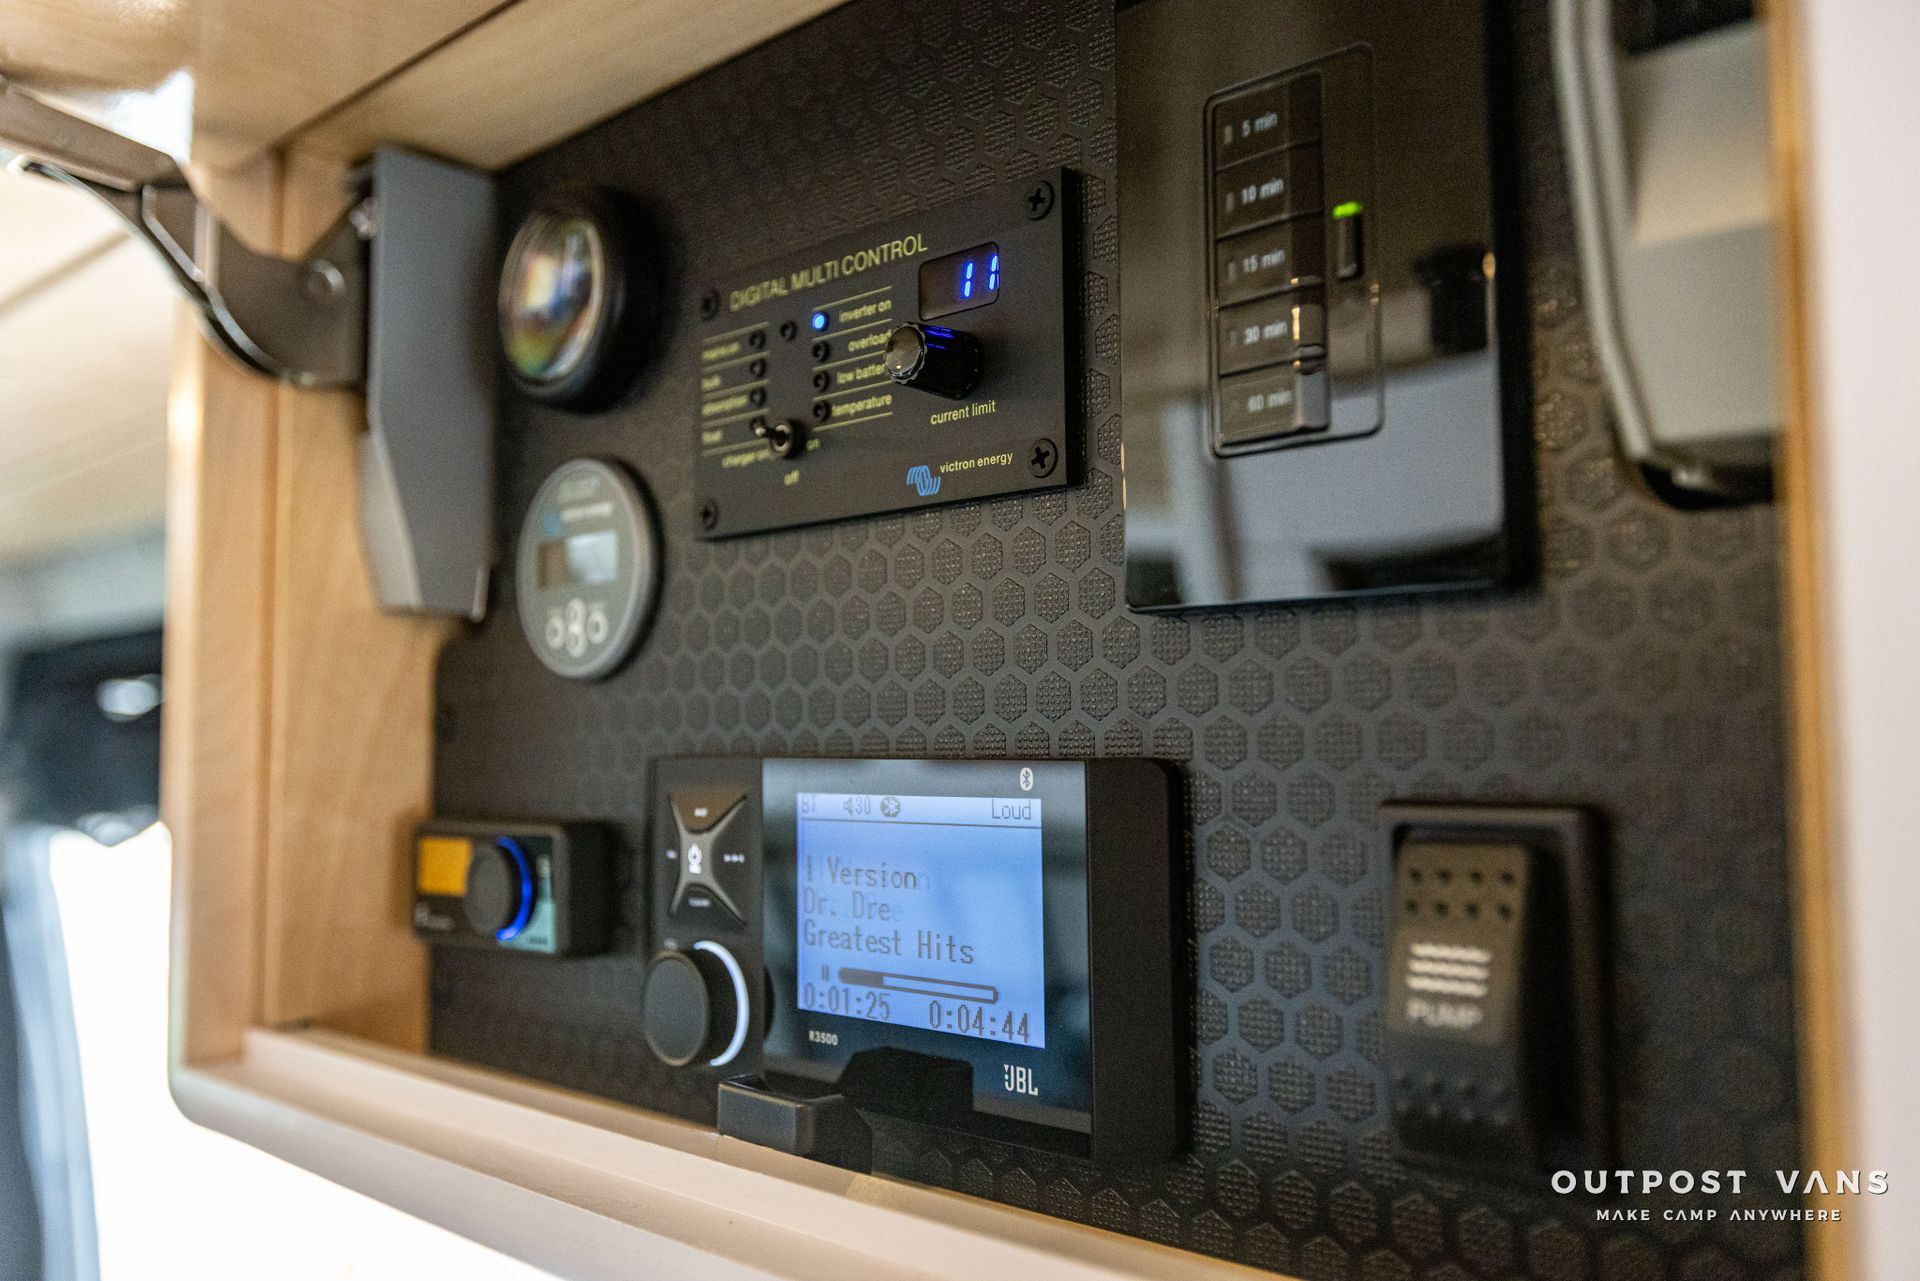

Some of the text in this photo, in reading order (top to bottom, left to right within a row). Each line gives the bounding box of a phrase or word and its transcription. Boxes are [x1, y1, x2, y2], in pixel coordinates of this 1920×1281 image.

[1241, 111, 1279, 138] 5 min
[1241, 175, 1285, 205] 10 min
[729, 233, 928, 311] DIGITAL MULTI CONTROL
[1242, 247, 1286, 274] 15 min
[839, 300, 893, 323] inverter on
[1243, 319, 1289, 345] 30 min
[836, 362, 889, 385] low batter
[831, 394, 893, 418] temperature
[930, 399, 996, 425] current limit
[1267, 389, 1293, 409] min
[939, 451, 1014, 474] victron energy
[783, 469, 800, 486] off
[990, 799, 1032, 821] Loud
[827, 855, 918, 890] Version
[803, 888, 892, 922] Dr. Dre
[803, 919, 975, 965] Greatest Hits
[803, 982, 1031, 1044] 0:01:25 0:04:44
[808, 1030, 839, 1047] R3500
[1003, 1064, 1039, 1097] JBL
